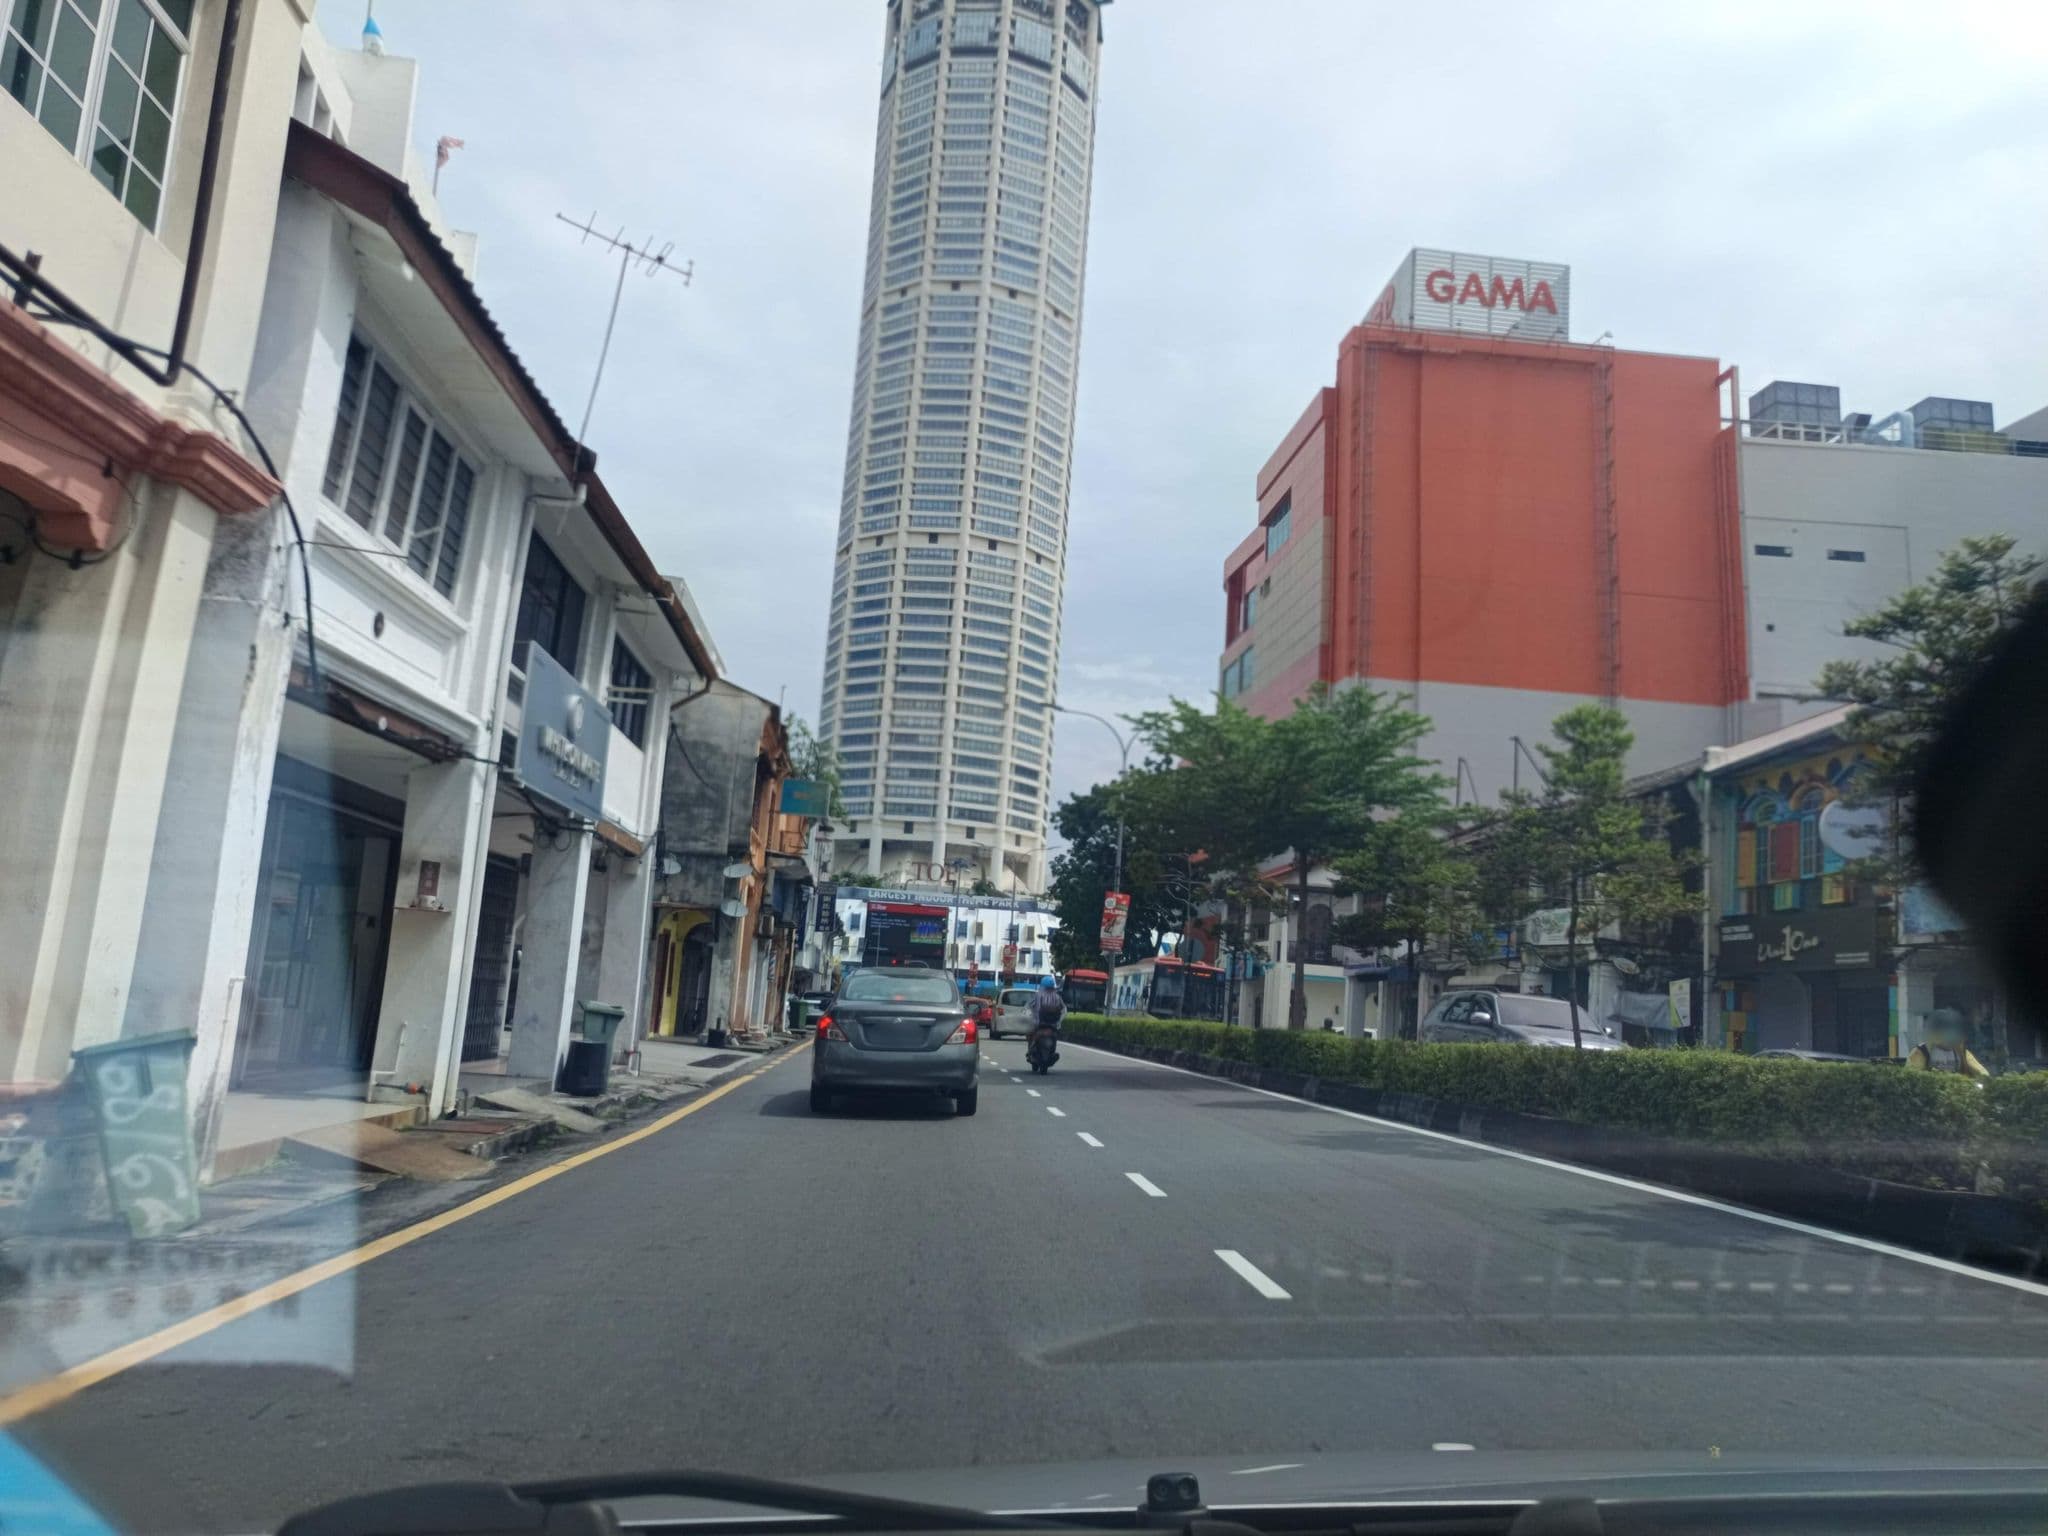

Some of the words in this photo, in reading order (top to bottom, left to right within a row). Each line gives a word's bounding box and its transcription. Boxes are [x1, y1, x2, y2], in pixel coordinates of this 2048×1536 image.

[1425, 268, 1558, 315] GAMA
[868, 890, 911, 901] LARGEST
[914, 894, 954, 904] INDOOR
[991, 898, 1020, 909] PARK
